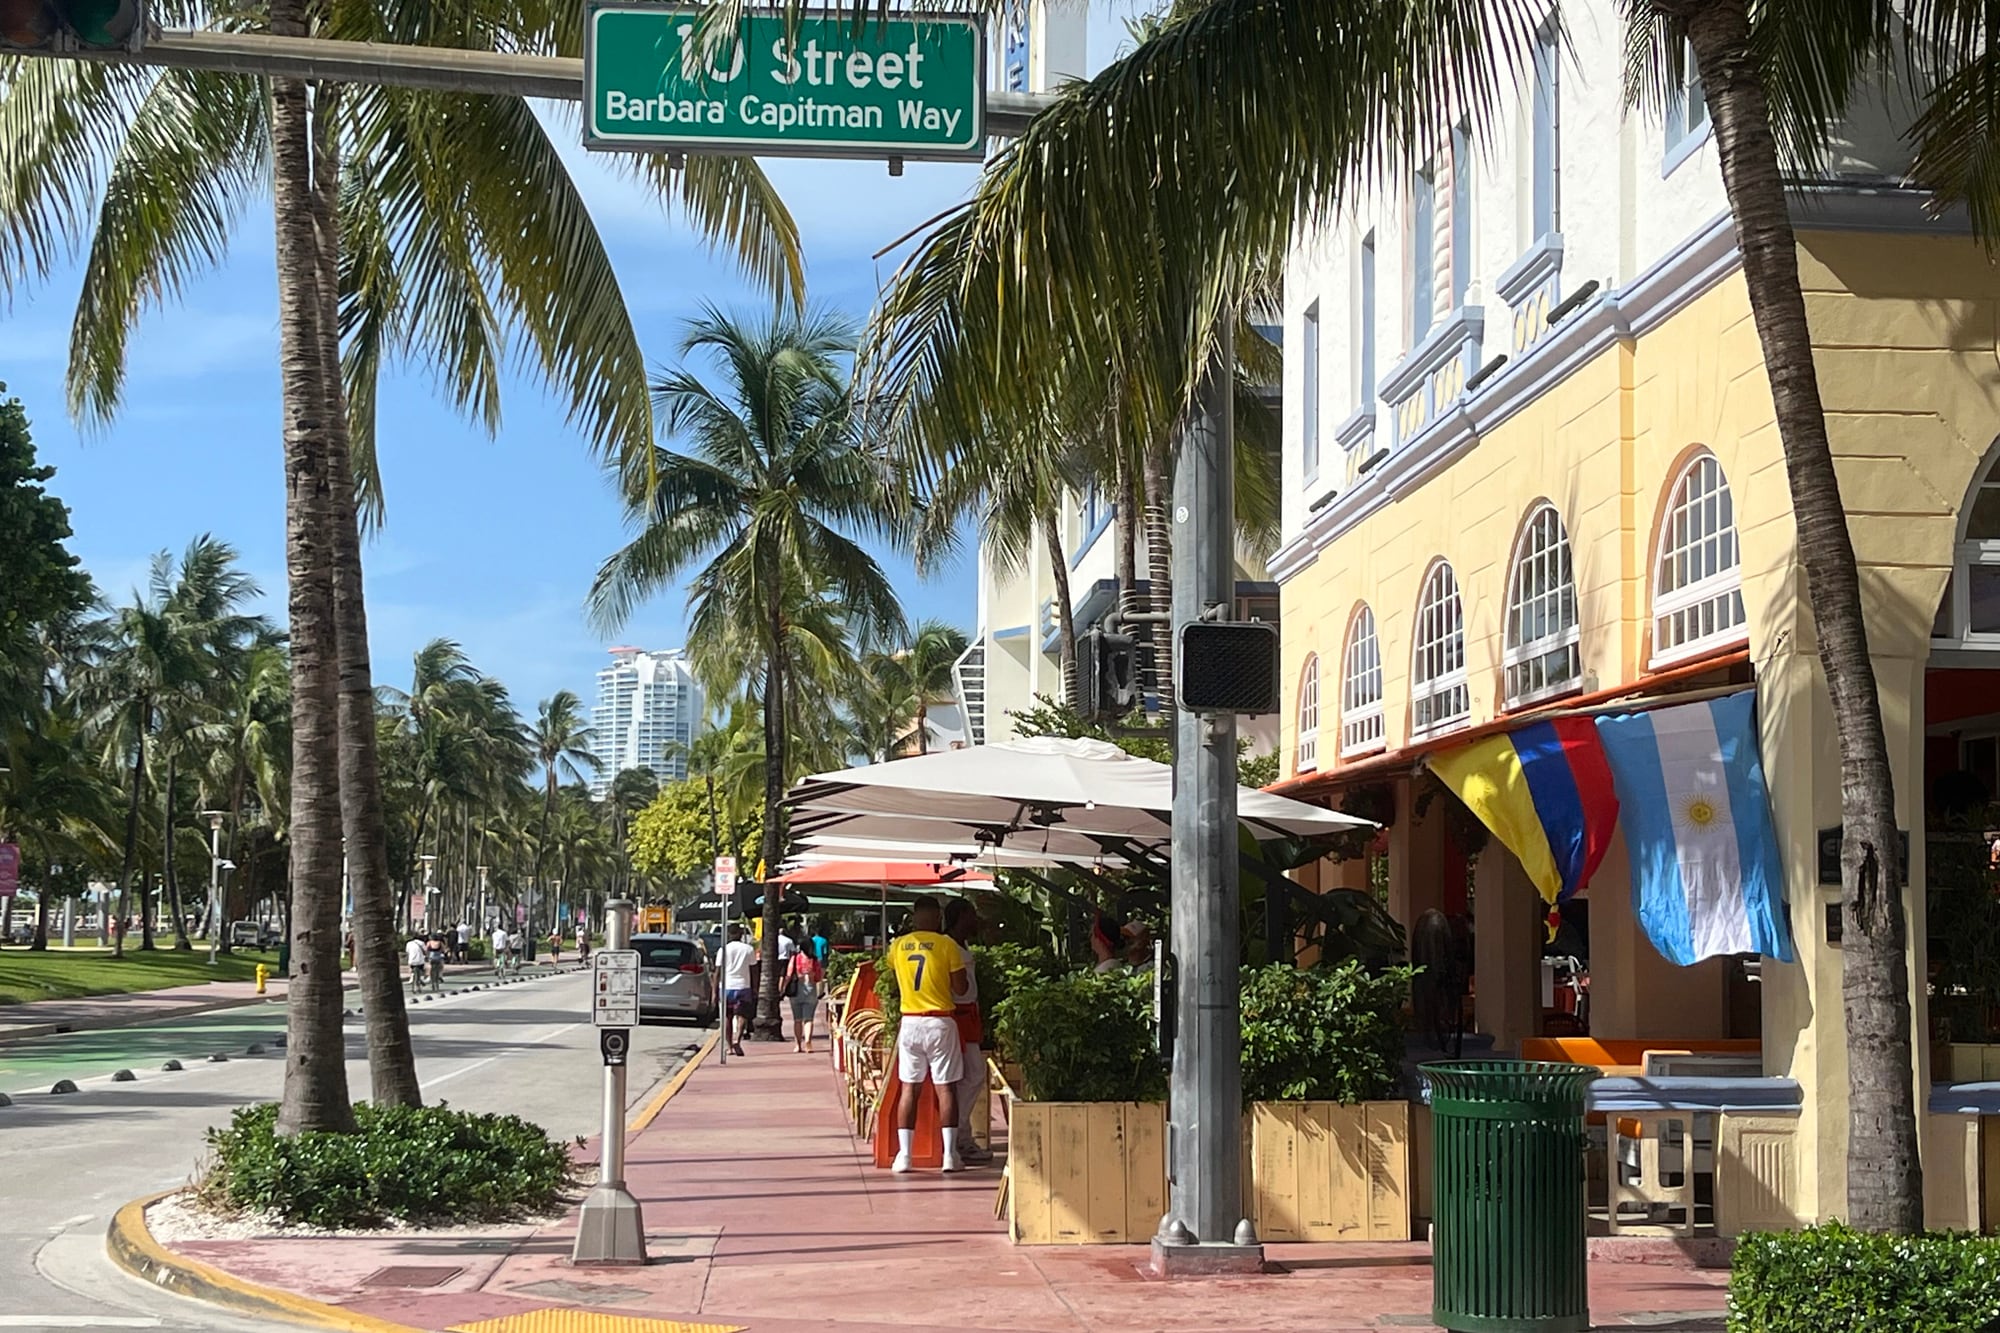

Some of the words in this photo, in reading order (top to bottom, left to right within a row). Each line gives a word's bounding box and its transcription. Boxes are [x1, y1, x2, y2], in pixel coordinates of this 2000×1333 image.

[676, 23, 745, 84] 10
[770, 37, 924, 89] Street
[606, 90, 725, 124] Barbara
[739, 94, 883, 133] Capitman
[898, 99, 962, 138] Way
[907, 954, 926, 991] 7
